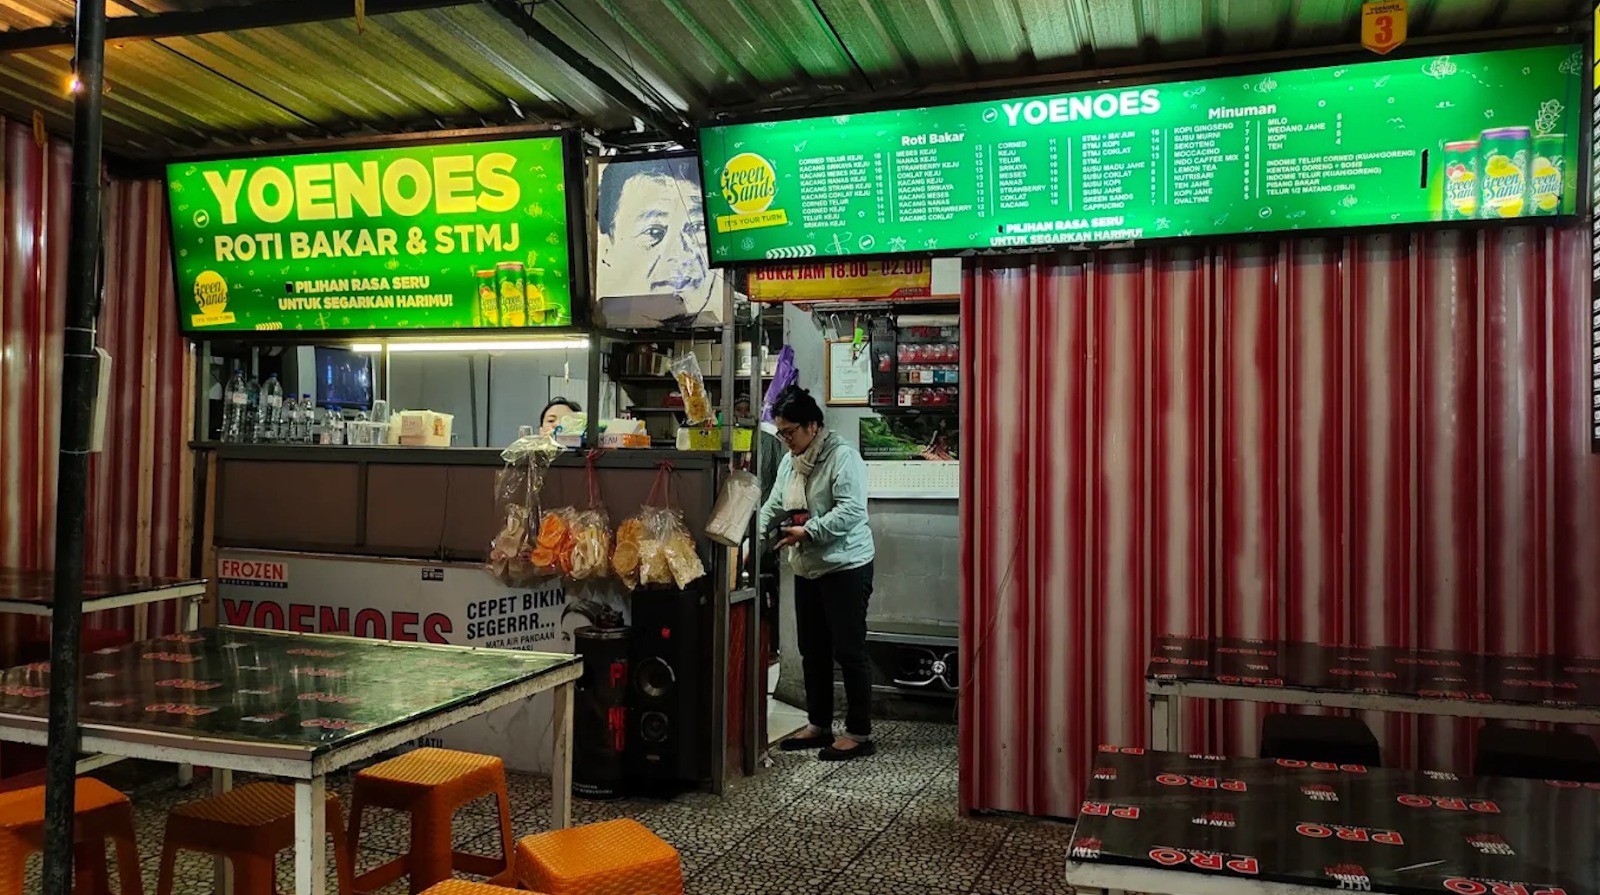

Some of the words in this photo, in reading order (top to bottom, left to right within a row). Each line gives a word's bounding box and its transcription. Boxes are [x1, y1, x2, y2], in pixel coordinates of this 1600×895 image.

[1374, 16, 1393, 44] 3
[1002, 88, 1161, 126] YOENOES
[1208, 103, 1277, 120] Minuman
[1196, 132, 1221, 140] MURNI
[1268, 125, 1302, 134] WEDANG
[1304, 123, 1326, 131] JAHE
[901, 134, 926, 146] Roti
[929, 132, 964, 144] Bakar
[1174, 140, 1215, 150] SEKOTENG
[1268, 134, 1286, 142] KOPI
[1102, 147, 1131, 156] COKLAT
[1299, 156, 1321, 164] TELUR
[1174, 172, 1214, 181] NUTRISARI
[1266, 166, 1300, 174] KENTANG
[1302, 163, 1333, 172] GORENG
[1298, 171, 1321, 179] TELUR
[203, 152, 521, 224] YOENOES
[728, 176, 776, 205] Sands
[1000, 185, 1046, 193] STRAWBERRY
[1266, 188, 1290, 196] TELUR
[1302, 185, 1332, 193] MATANG
[1174, 196, 1209, 205] OVALTINE
[1006, 222, 1054, 234] PILIHAN
[1055, 219, 1090, 230] RASA
[1091, 216, 1124, 228] SERU
[214, 234, 283, 262] ROTI
[291, 228, 398, 259] BAKAR
[406, 227, 427, 254] &
[435, 224, 520, 254] STMJ
[990, 235, 1028, 247] UNTUK
[1030, 231, 1092, 244] SEGARKAN
[1094, 228, 1143, 241] HARIMU!
[756, 265, 794, 281] BUKA
[798, 263, 825, 280] JAM
[830, 262, 868, 279] 18.00
[296, 278, 349, 293] PILIHAN
[352, 277, 389, 292] RASA
[392, 275, 429, 290] SERU
[278, 296, 321, 310] UNTUK
[323, 295, 394, 309] SEGARKAN
[396, 293, 452, 308] HARIMU!
[222, 560, 283, 580] FROZEN
[467, 596, 518, 620] CEPET
[522, 588, 566, 610] BIKIN
[222, 598, 453, 645] YOENOES
[467, 613, 555, 640] SEGERRR...
[485, 639, 506, 649] MATA
[507, 638, 518, 647] AIR
[521, 632, 555, 645] PANDAAN
[1156, 773, 1247, 792] PRO
[1296, 823, 1404, 846] PRO
[1149, 847, 1259, 875] PRO
